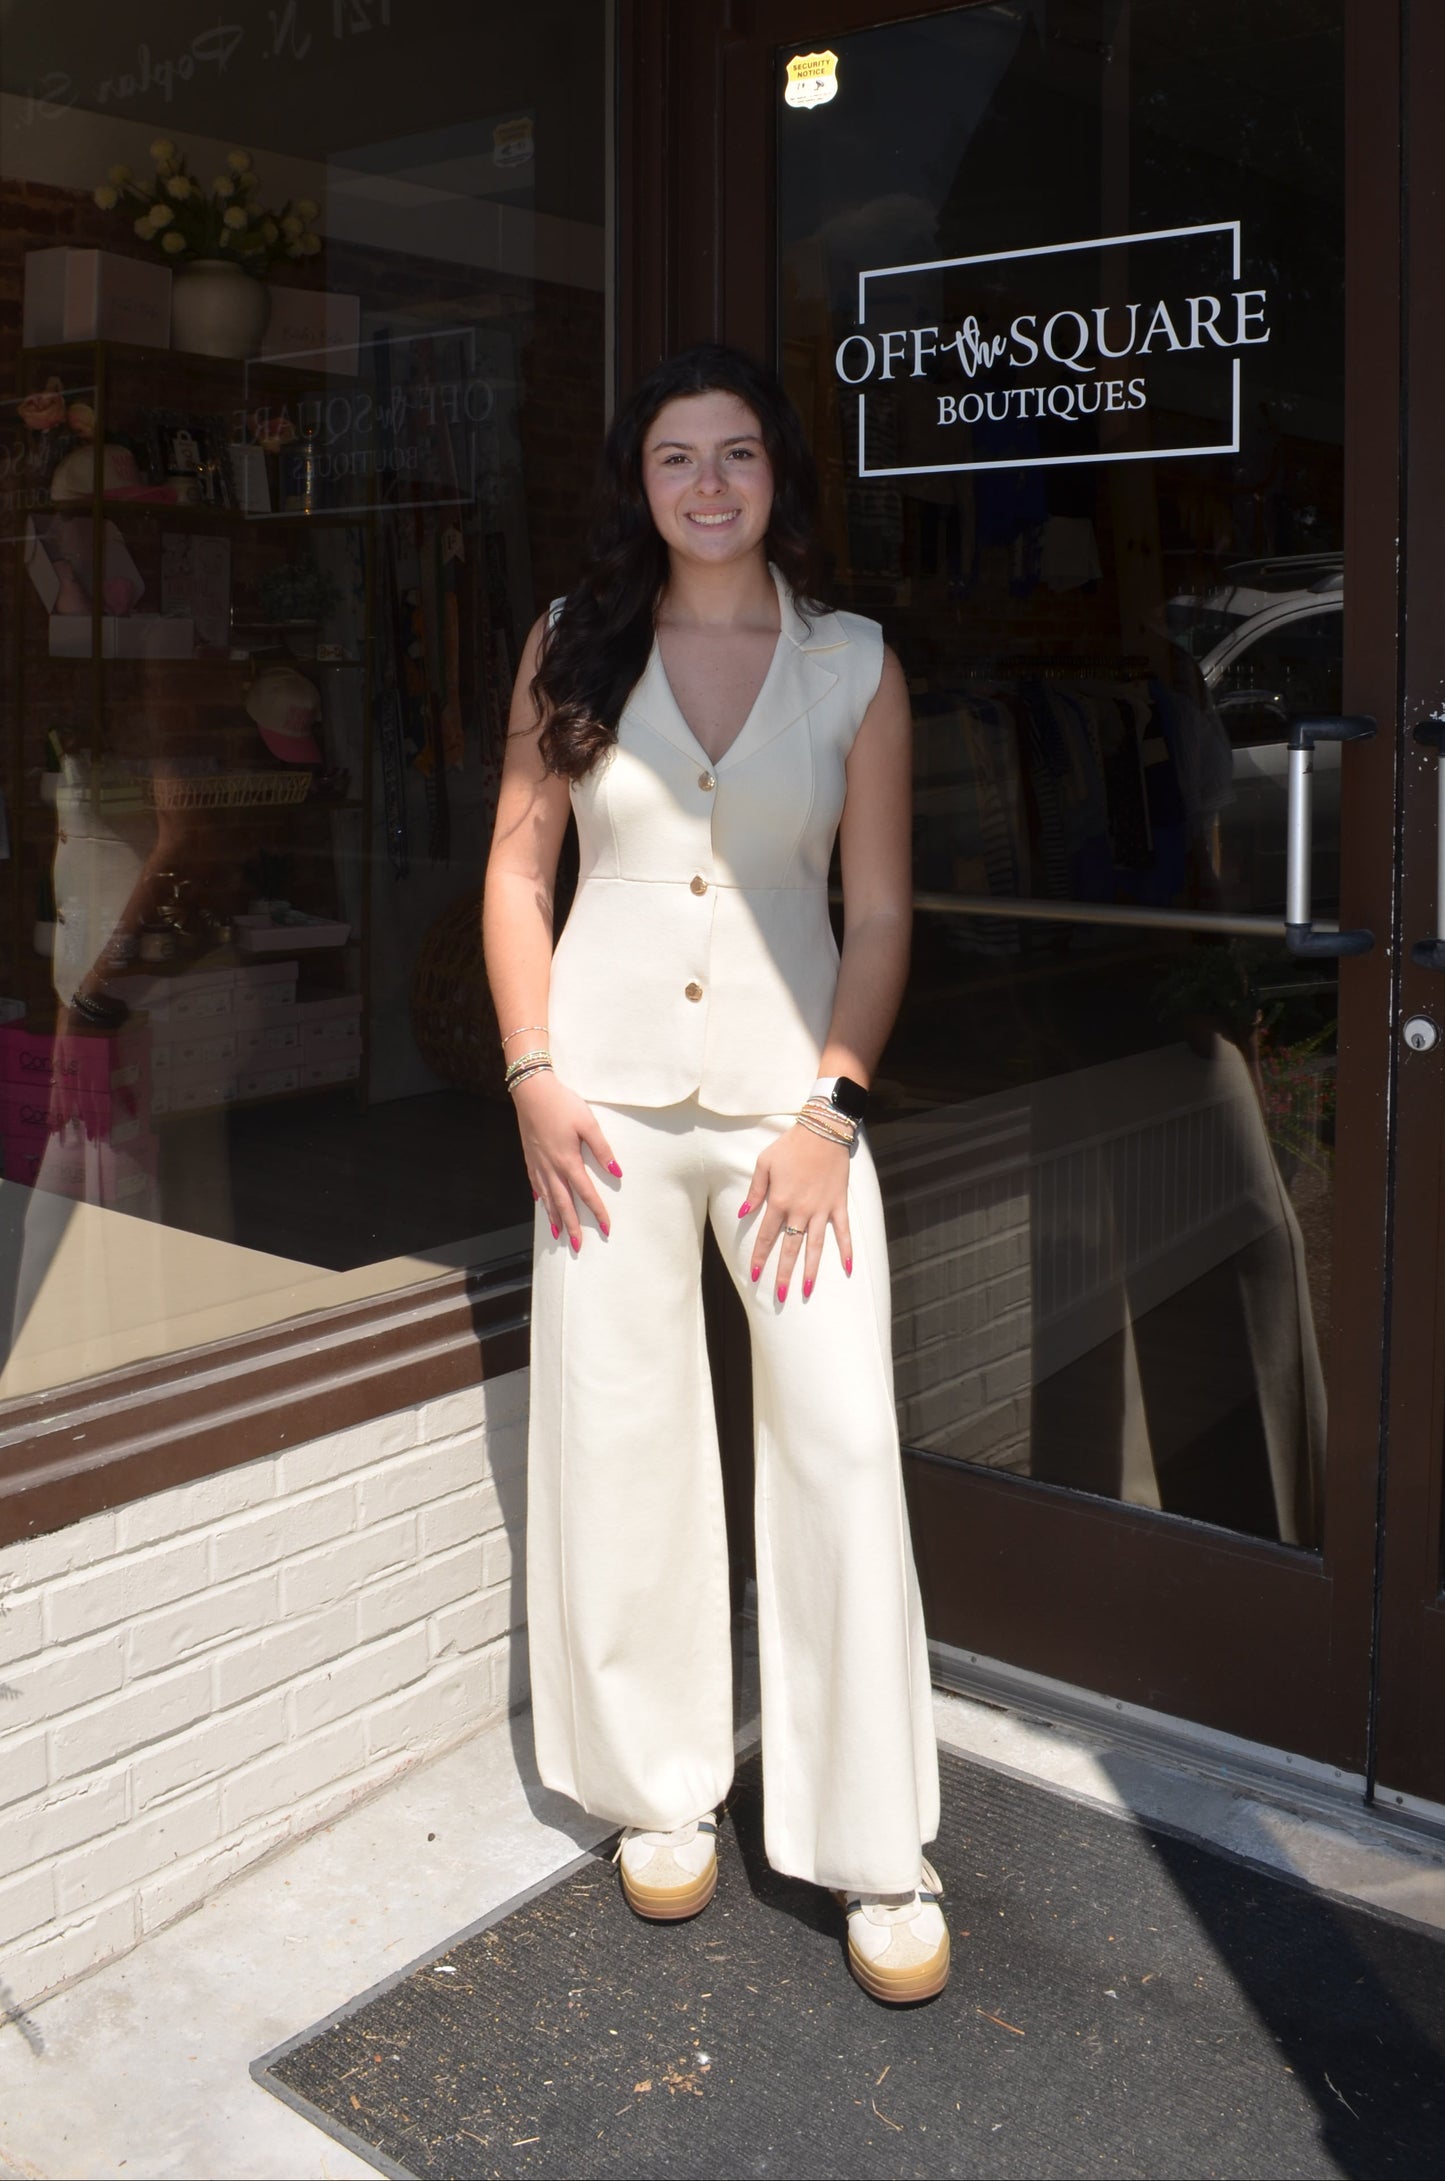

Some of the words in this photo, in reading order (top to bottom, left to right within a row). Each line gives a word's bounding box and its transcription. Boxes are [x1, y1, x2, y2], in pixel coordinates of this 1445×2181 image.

[793, 59, 831, 71] SECURITY
[797, 68, 826, 78] NOTICE
[835, 326, 940, 384] OFF
[940, 315, 1008, 378] the
[1008, 289, 1272, 373] SQUARE
[936, 377, 1147, 426] BOUTIQUES
[19, 1051, 80, 1076] Cors
